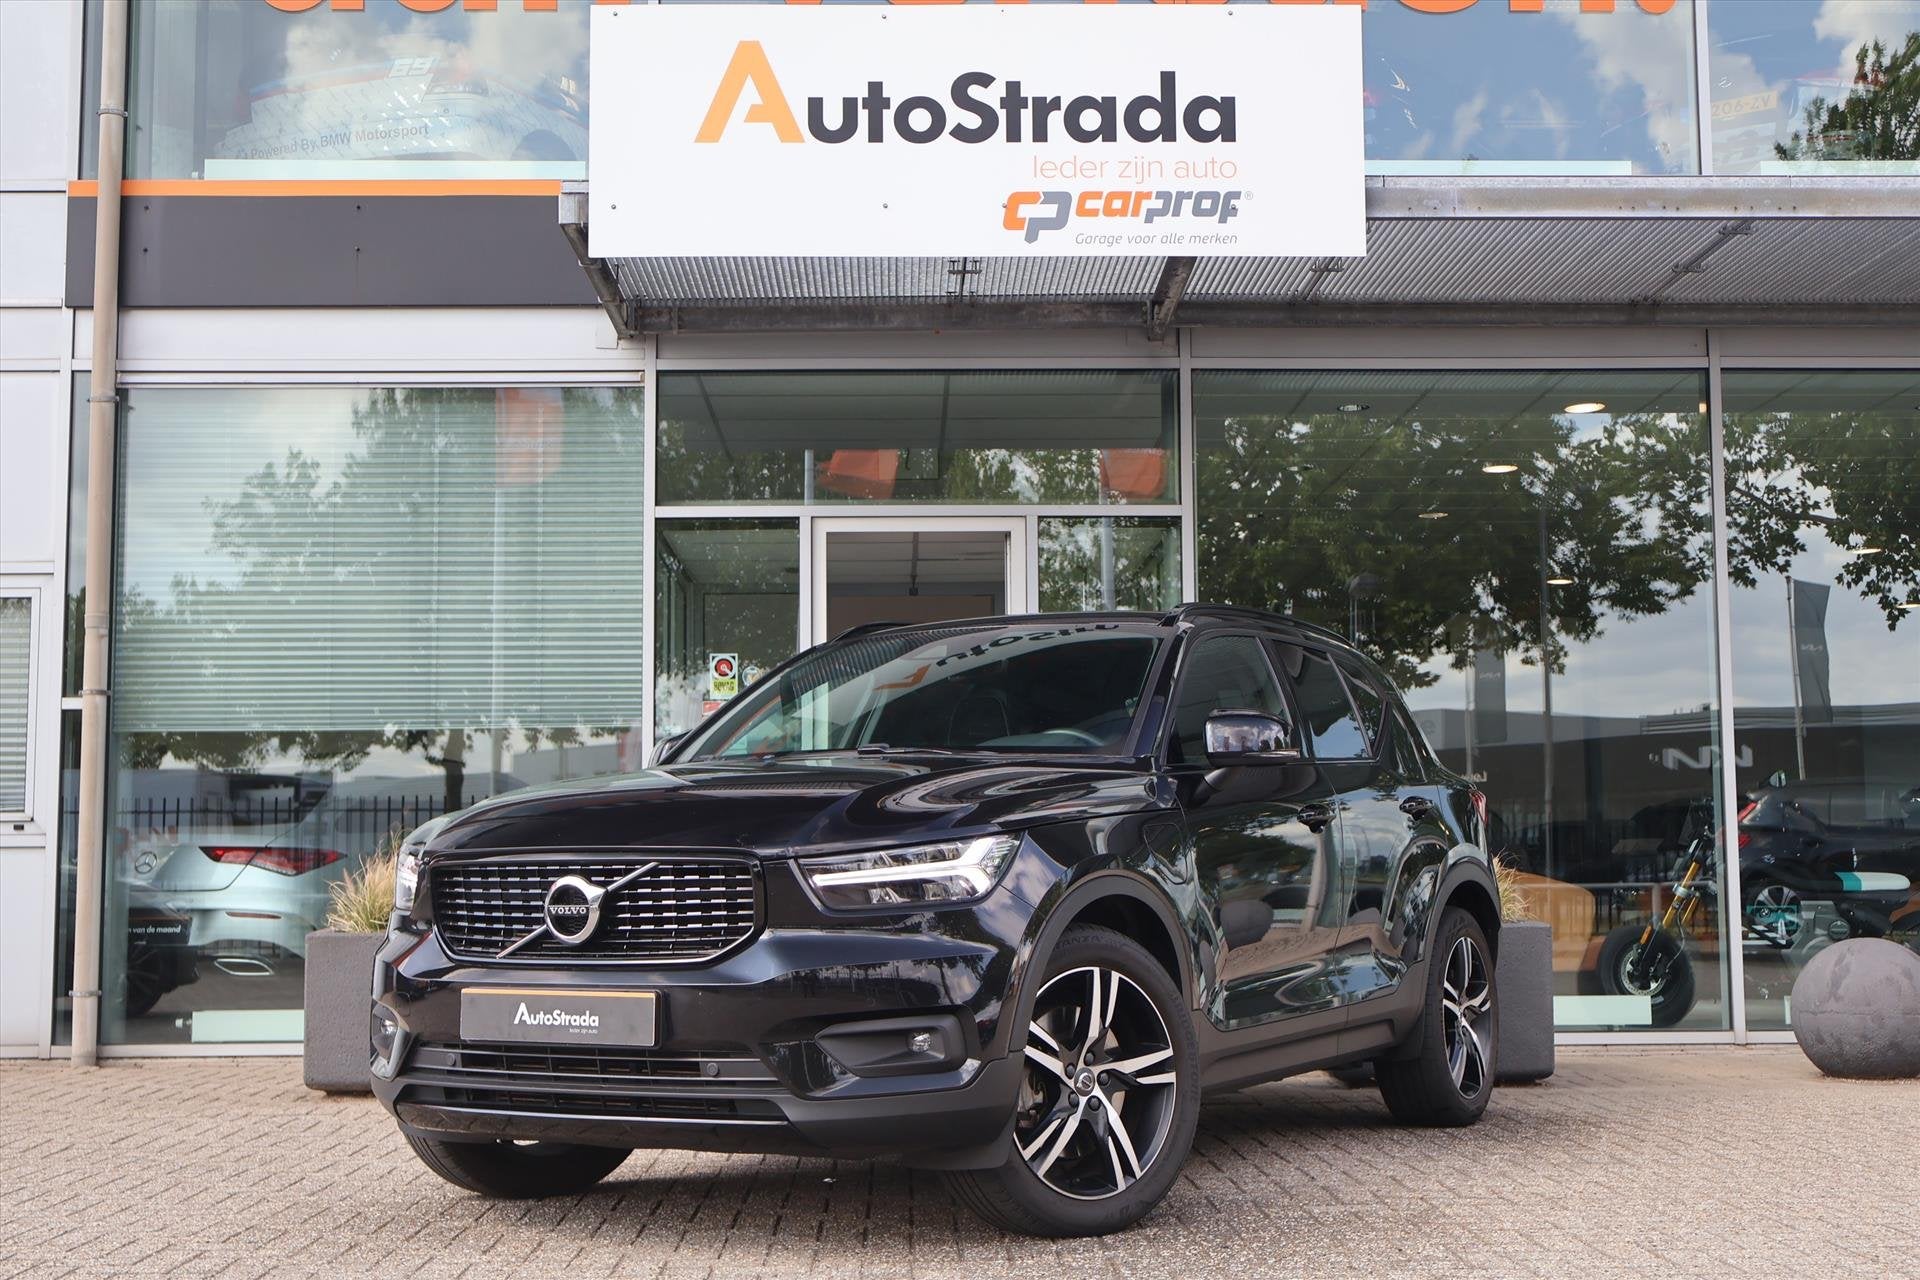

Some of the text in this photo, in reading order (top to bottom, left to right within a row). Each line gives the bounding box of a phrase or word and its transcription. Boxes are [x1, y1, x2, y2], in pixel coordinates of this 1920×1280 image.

[694, 40, 1237, 144] AutoStrada
[302, 136, 319, 153] By
[320, 132, 351, 149] BMW
[354, 122, 430, 142] Motorsport
[1033, 155, 1237, 184] Ieder zijn auto
[1075, 233, 1238, 247] Garage voor alle merken
[549, 906, 587, 915] VOLVO
[513, 1002, 599, 1027] AutoStrada
